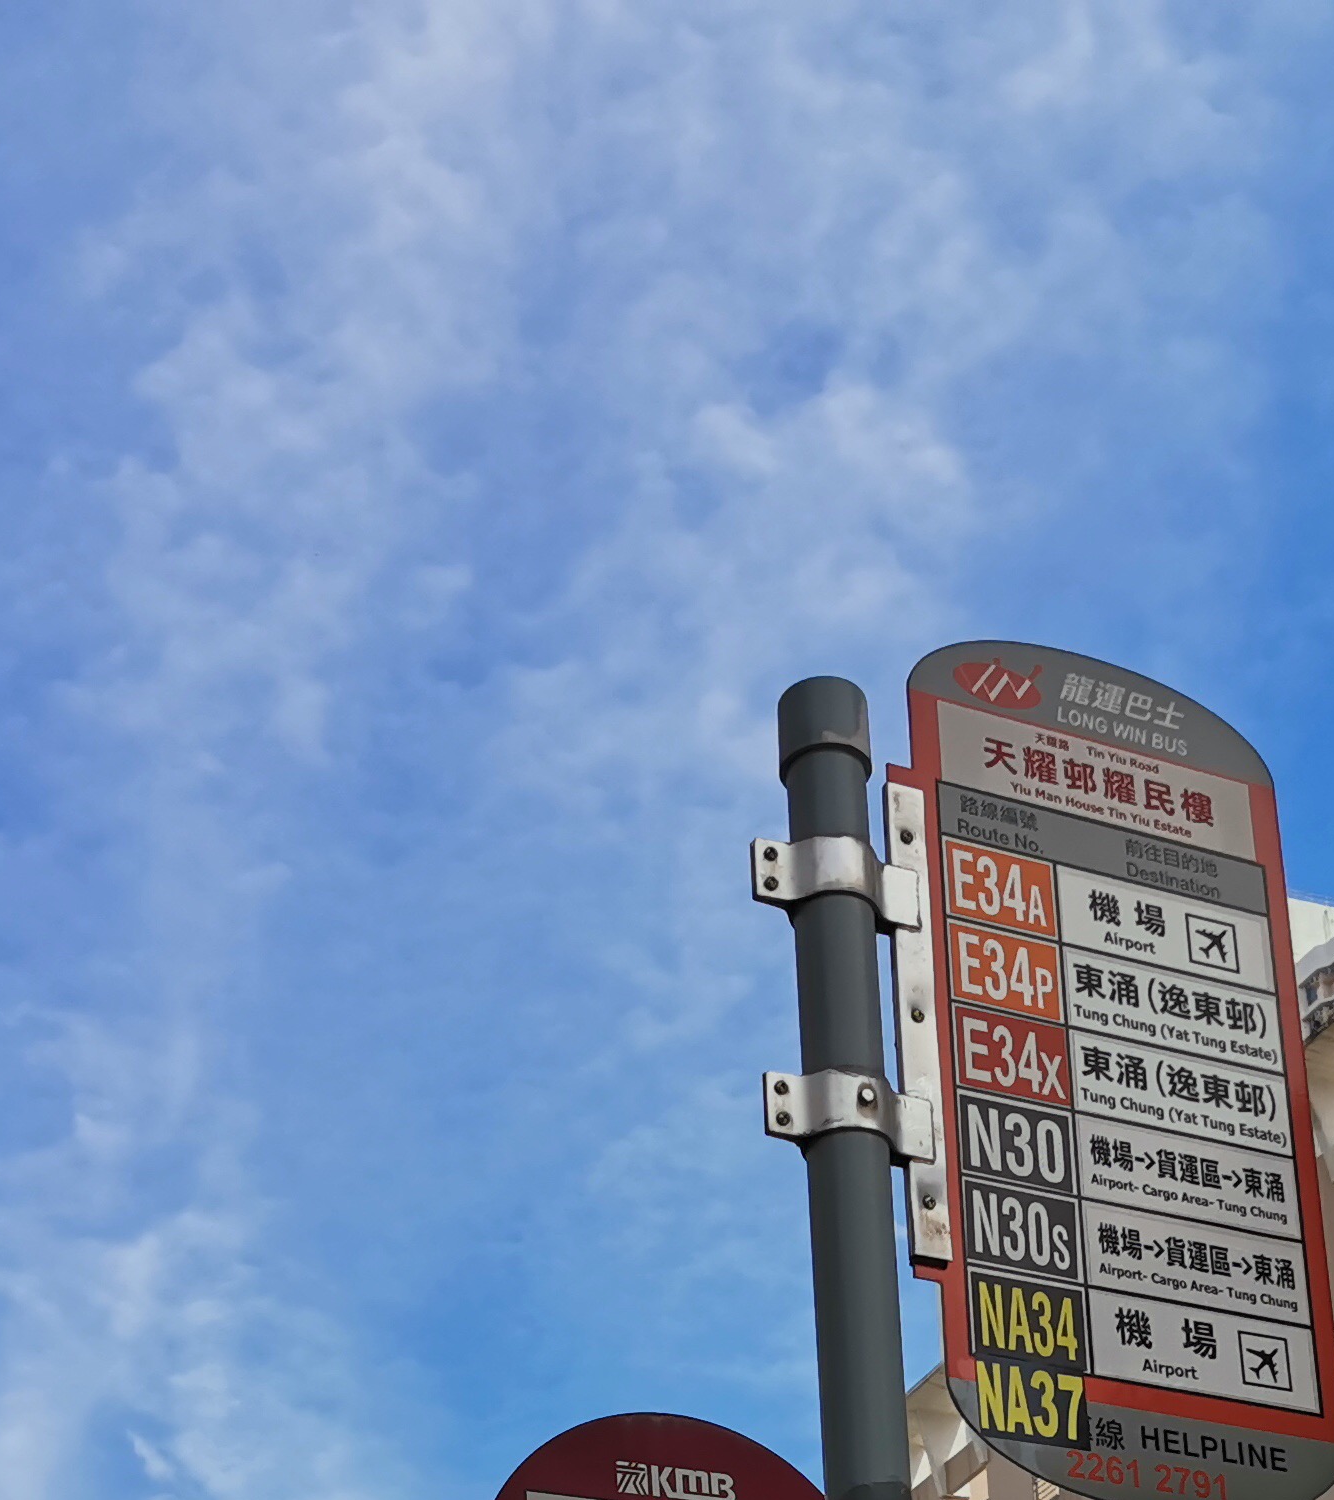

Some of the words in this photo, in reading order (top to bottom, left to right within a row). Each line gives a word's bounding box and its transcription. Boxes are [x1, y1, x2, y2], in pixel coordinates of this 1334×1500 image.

[1059, 672, 1185, 731] 龍運巴士
[1057, 706, 1108, 735] LONG
[1113, 721, 1147, 746] WIN
[1151, 734, 1188, 758] BUS
[983, 736, 1215, 828] 天耀邨耀民樓
[1086, 746, 1105, 760] Tin
[1107, 752, 1127, 766] Yiu
[1129, 757, 1160, 775] Road
[957, 819, 1010, 846] Route
[1014, 832, 1045, 855] No.
[960, 794, 1040, 833] 路線編號
[1010, 781, 1032, 797] Yiu
[1035, 788, 1062, 804] Man
[1066, 795, 1105, 816] House
[1107, 806, 1127, 821] Tin
[1129, 813, 1151, 829] Yiu
[1153, 819, 1192, 839] Estate
[1125, 838, 1218, 879] 前往目的地
[1125, 862, 1221, 900] Destination
[951, 847, 1048, 928] E34A
[1088, 889, 1167, 939] 機場
[957, 931, 1054, 1011] E34P
[1104, 931, 1157, 956] Airport
[965, 1014, 1066, 1100] E34X
[1074, 1005, 1108, 1027] Tung
[1113, 1013, 1157, 1037] Chung
[1160, 1023, 1190, 1043] (Yat
[1192, 1031, 1227, 1054] Tung
[1229, 1038, 1279, 1064] Estate)
[968, 1103, 1066, 1184] N30
[1081, 1087, 1115, 1111] Tung
[1120, 1095, 1165, 1120] Chung
[1168, 1105, 1197, 1128] (Yat
[1200, 1114, 1236, 1139] Tung
[1239, 1123, 1287, 1148] Estate)
[1142, 1183, 1178, 1205] Cargo
[1217, 1199, 1248, 1219] Tung
[1250, 1204, 1288, 1225] Chung
[1151, 1271, 1188, 1294] Cargo
[1226, 1286, 1258, 1308] Tung
[1260, 1292, 1299, 1314] Chung
[978, 1280, 1078, 1362] NA34
[1114, 1306, 1218, 1361] 機場
[1142, 1359, 1199, 1381] Airport
[976, 1360, 1084, 1442] NA37
[1067, 1450, 1140, 1489] 2261
[1087, 1416, 1125, 1451] 線
[1140, 1425, 1288, 1473] HELPLINE
